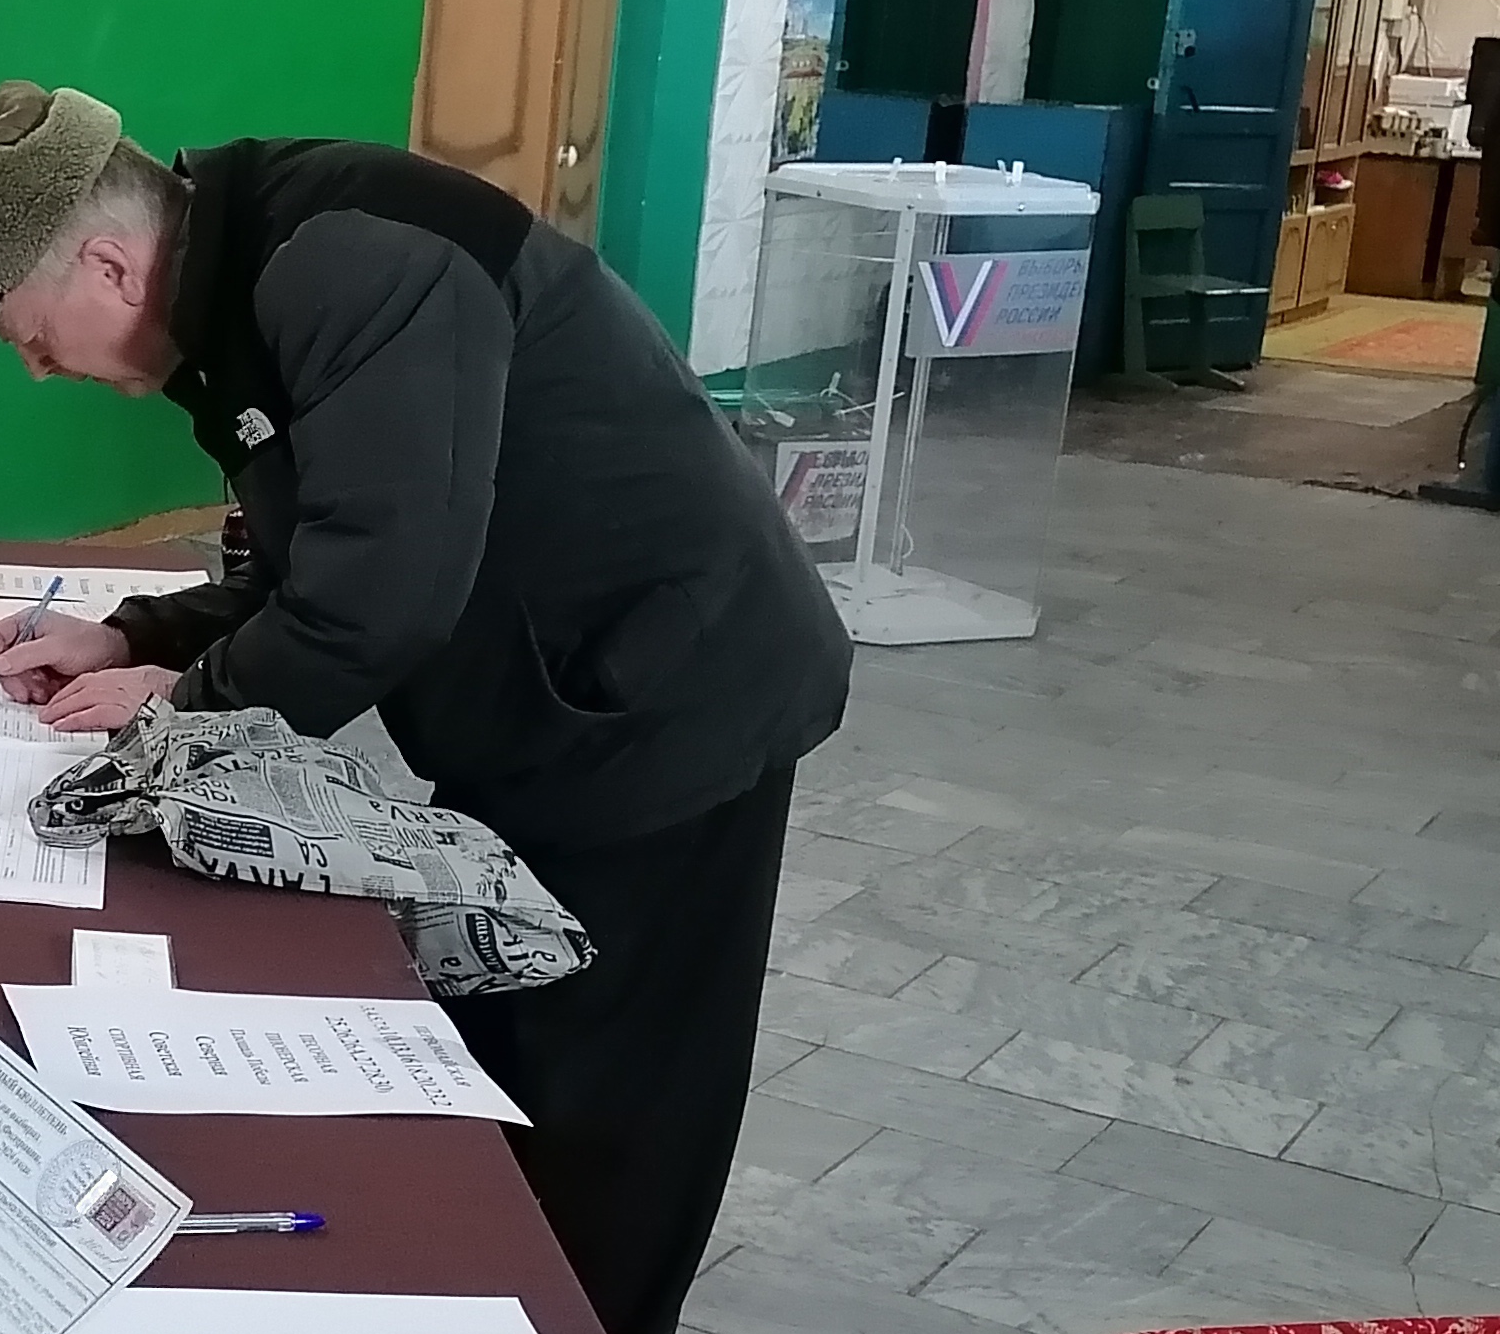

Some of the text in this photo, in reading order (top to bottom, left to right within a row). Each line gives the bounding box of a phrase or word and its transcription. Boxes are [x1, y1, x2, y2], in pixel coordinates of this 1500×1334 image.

[995, 305, 1063, 325] РОССИИ
[66, 1026, 102, 1077] Юбилейная
[108, 1027, 146, 1081] СПОРТИВНАЯ
[148, 1031, 183, 1077] Советская
[195, 1035, 229, 1076] Северная
[264, 1032, 310, 1083] ПИОНЕРСКАЯ
[298, 1034, 339, 1074] ПЕСОЧНАЯ
